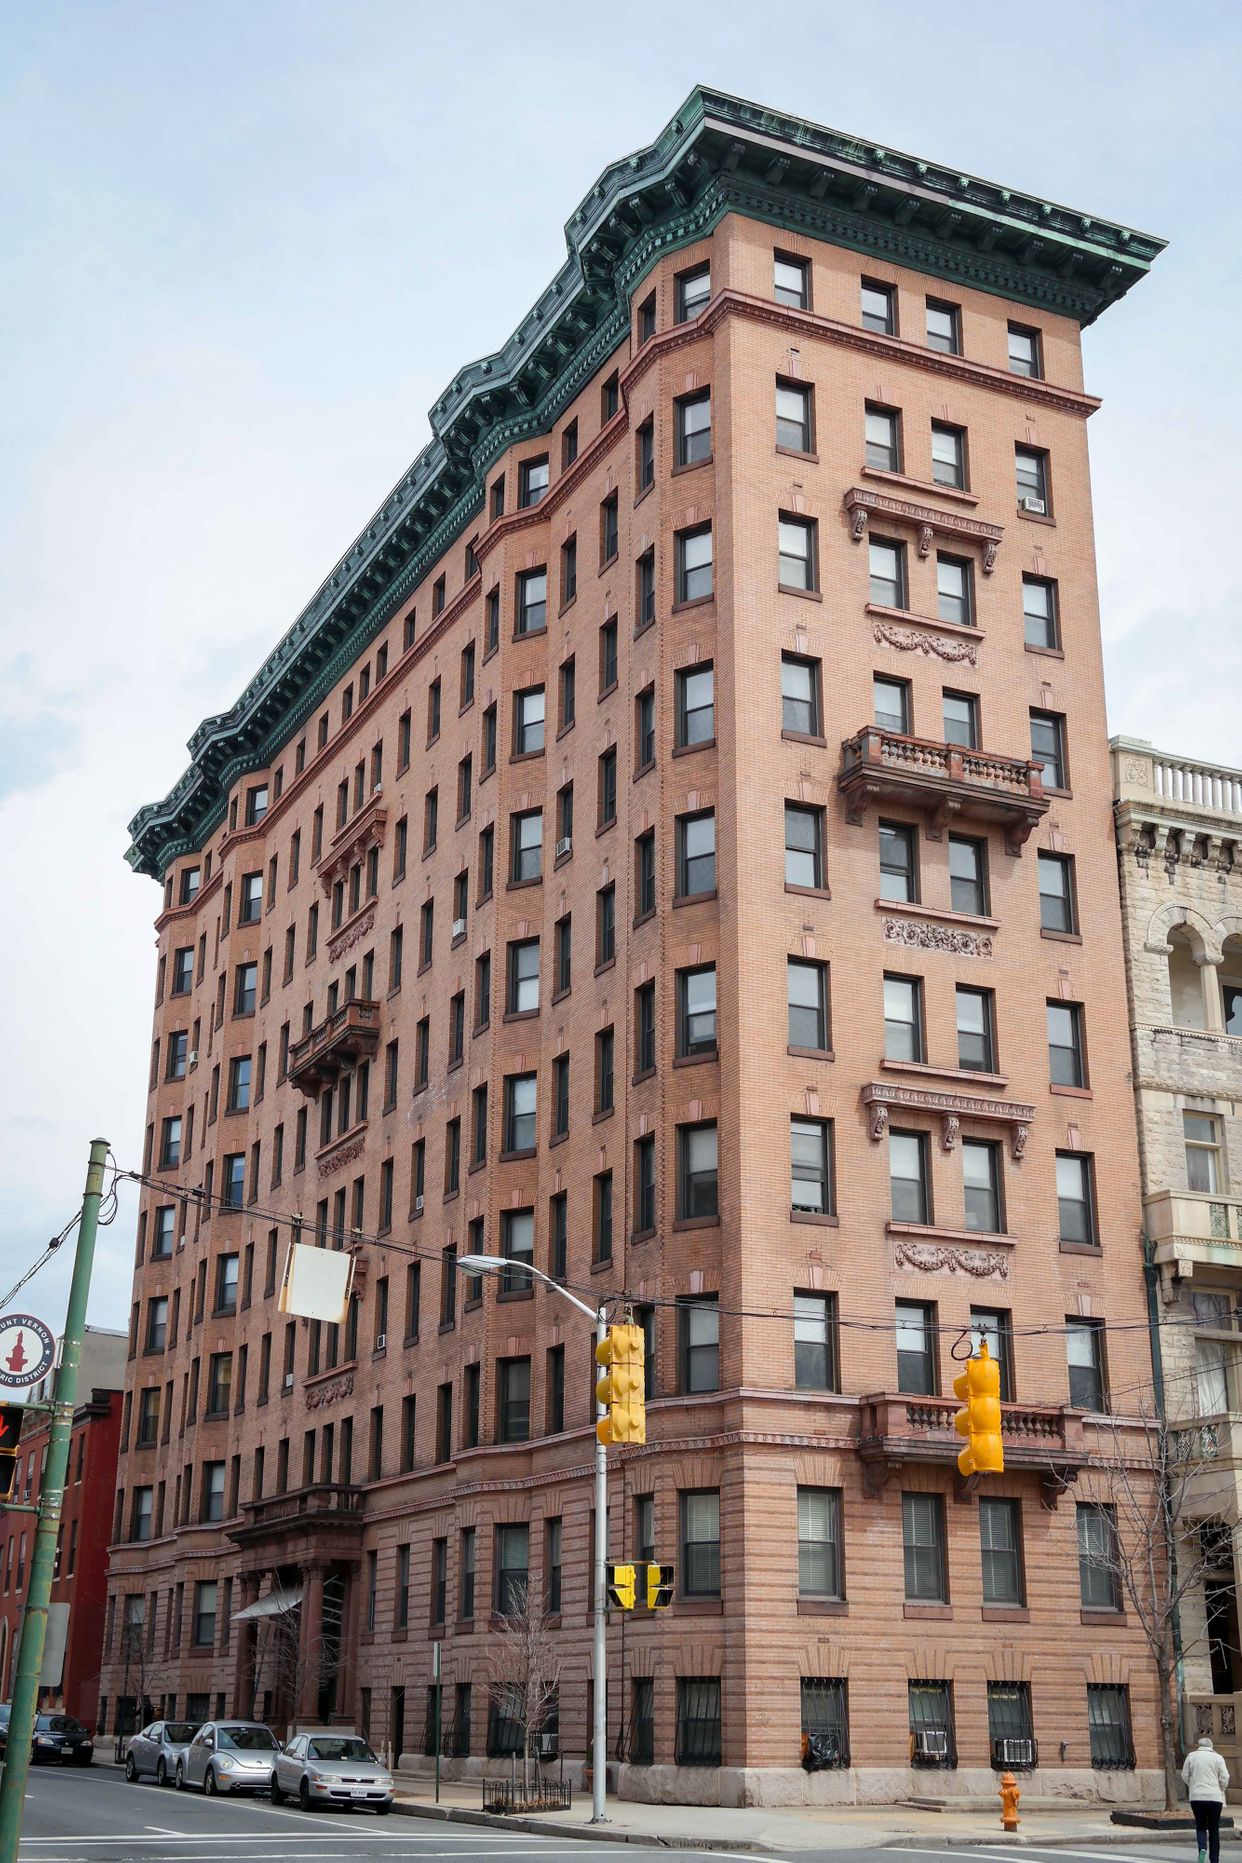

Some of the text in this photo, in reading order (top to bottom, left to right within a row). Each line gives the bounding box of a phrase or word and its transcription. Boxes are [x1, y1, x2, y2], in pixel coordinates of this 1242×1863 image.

[0, 1318, 50, 1344] UNT VERNON
[16, 1361, 48, 1384] DISTRICT
